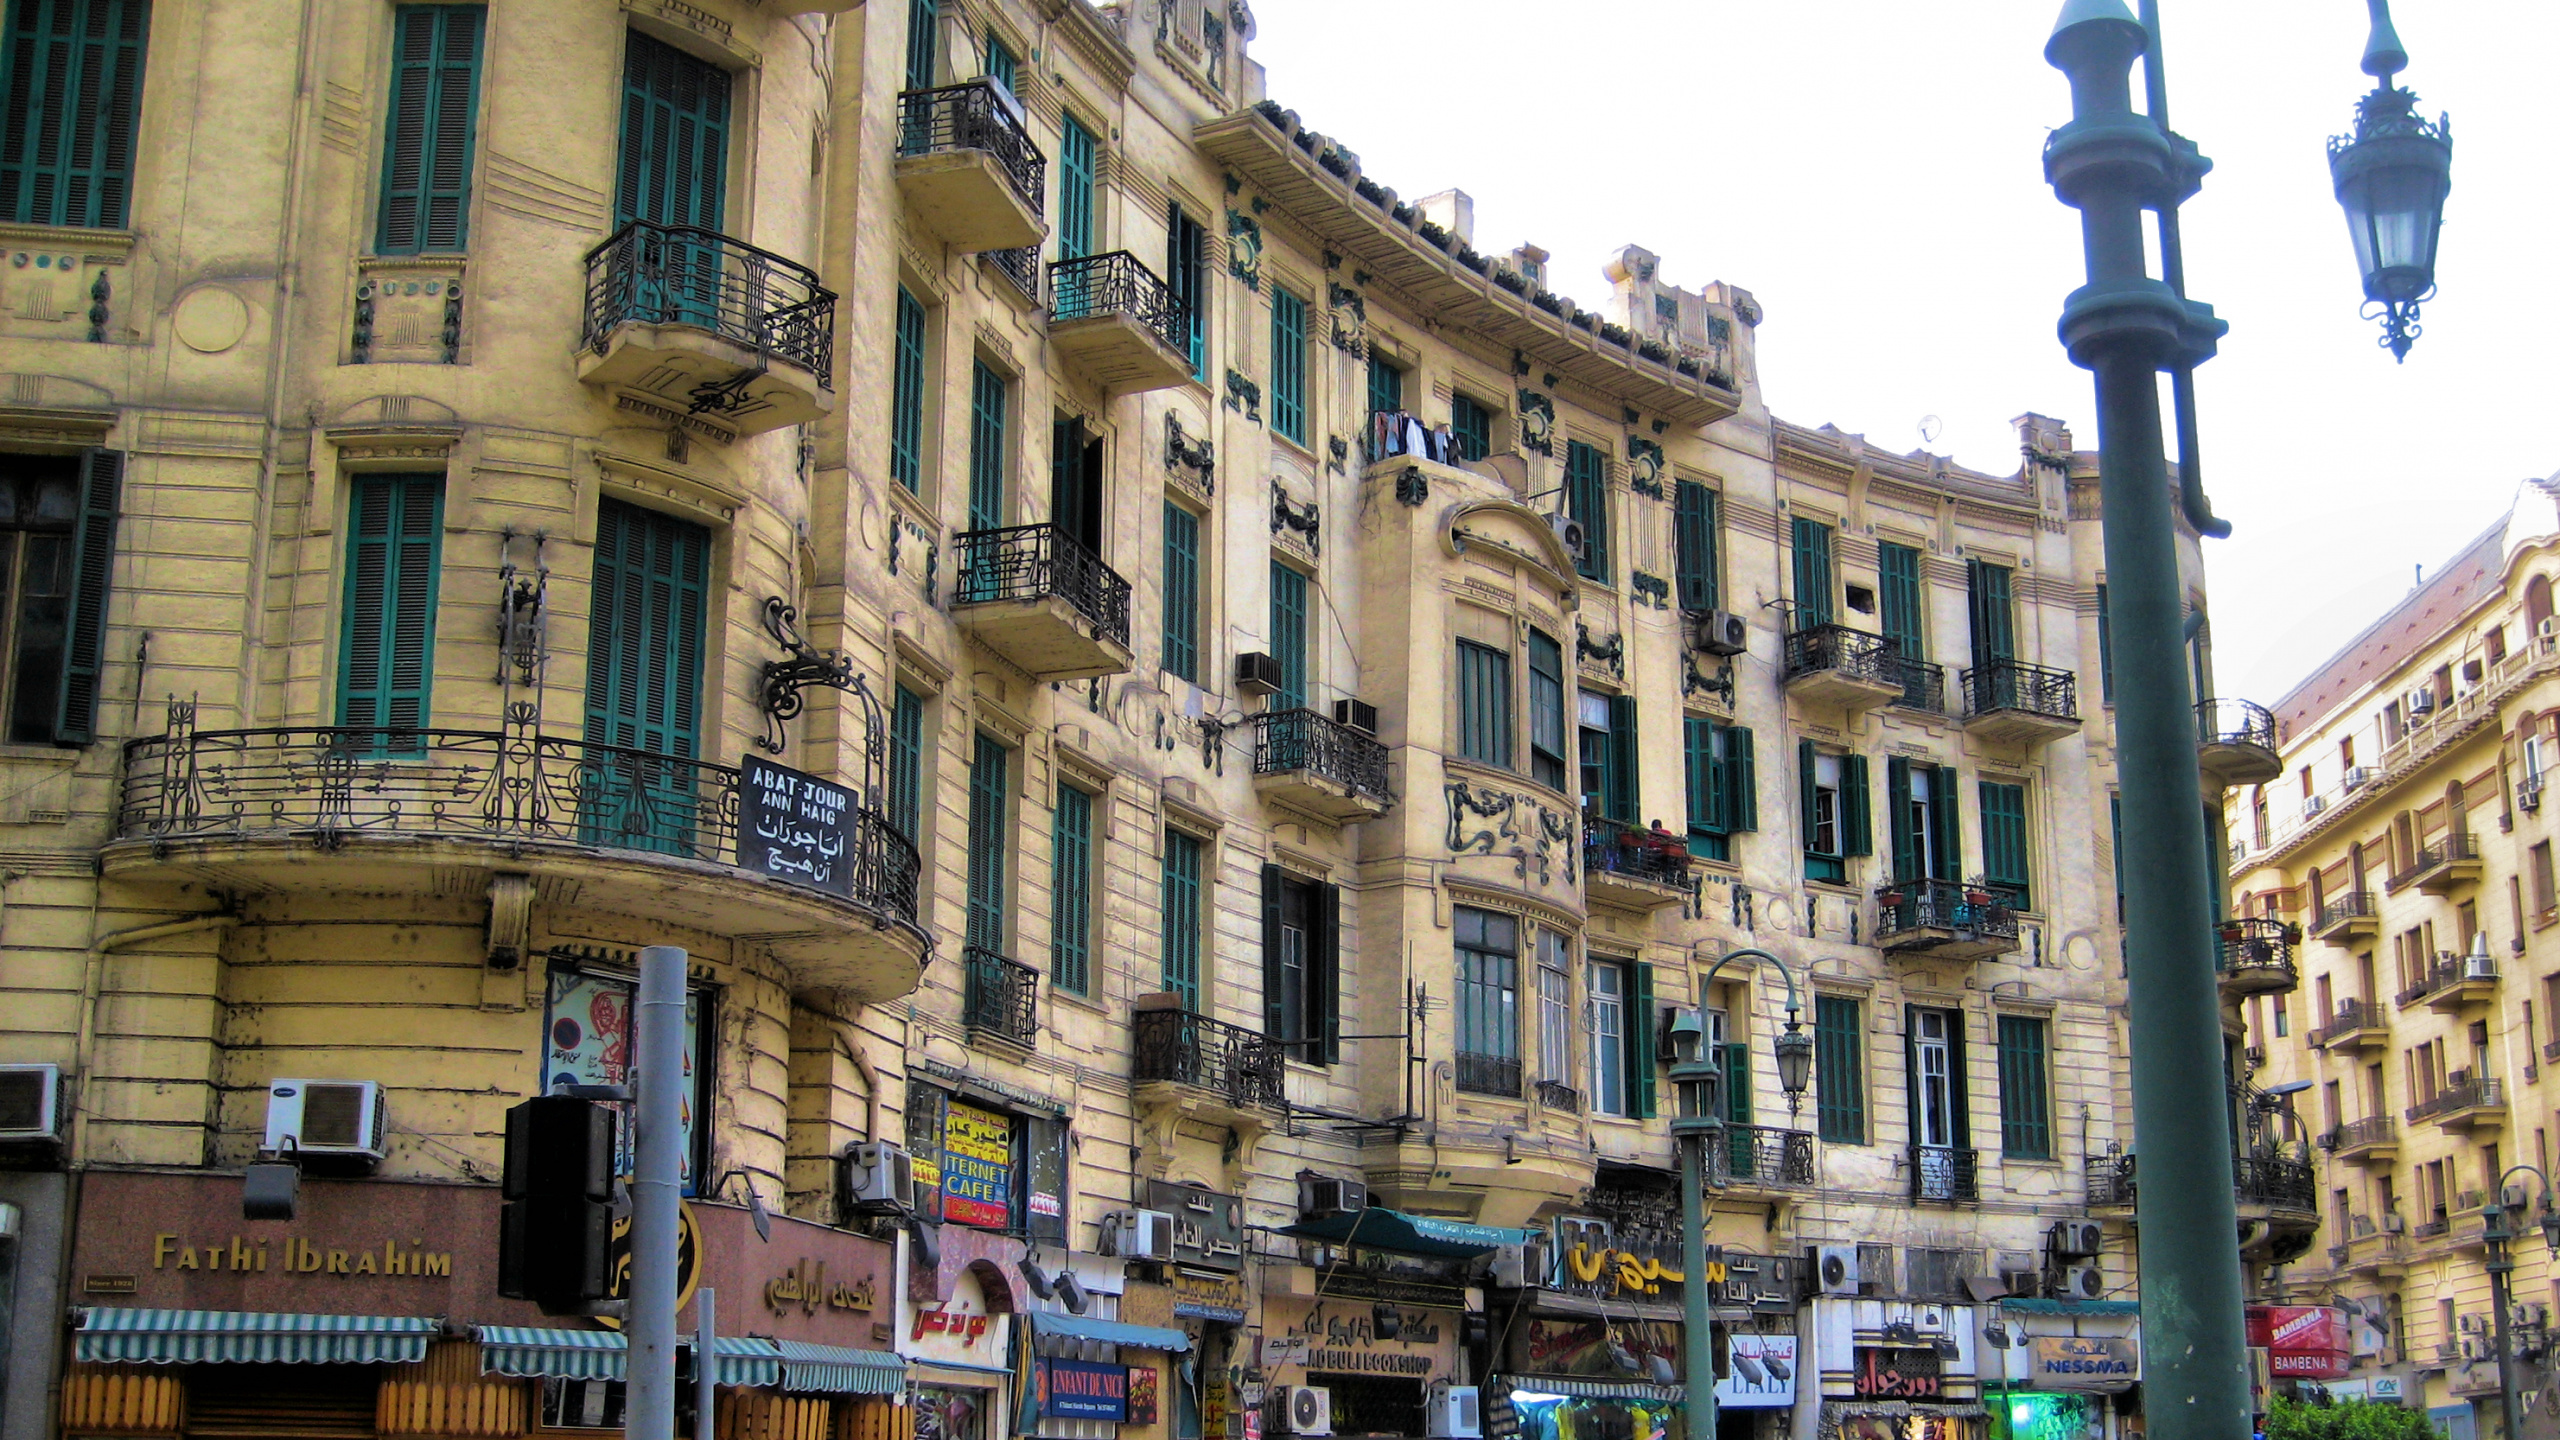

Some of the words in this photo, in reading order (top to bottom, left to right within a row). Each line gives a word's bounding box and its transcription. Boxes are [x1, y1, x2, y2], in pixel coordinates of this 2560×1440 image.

[761, 790, 792, 812] ANN
[801, 802, 836, 826] HAIG
[946, 1176, 994, 1202] CAFE
[2271, 1308, 2323, 1341] BAMBENA
[2045, 1359, 2128, 1375] NESSMA
[2274, 1356, 2328, 1370] BAMBENA
[1053, 1369, 1088, 1396] ENFANT
[1089, 1373, 1101, 1397] DE
[1103, 1374, 1124, 1398] NICE
